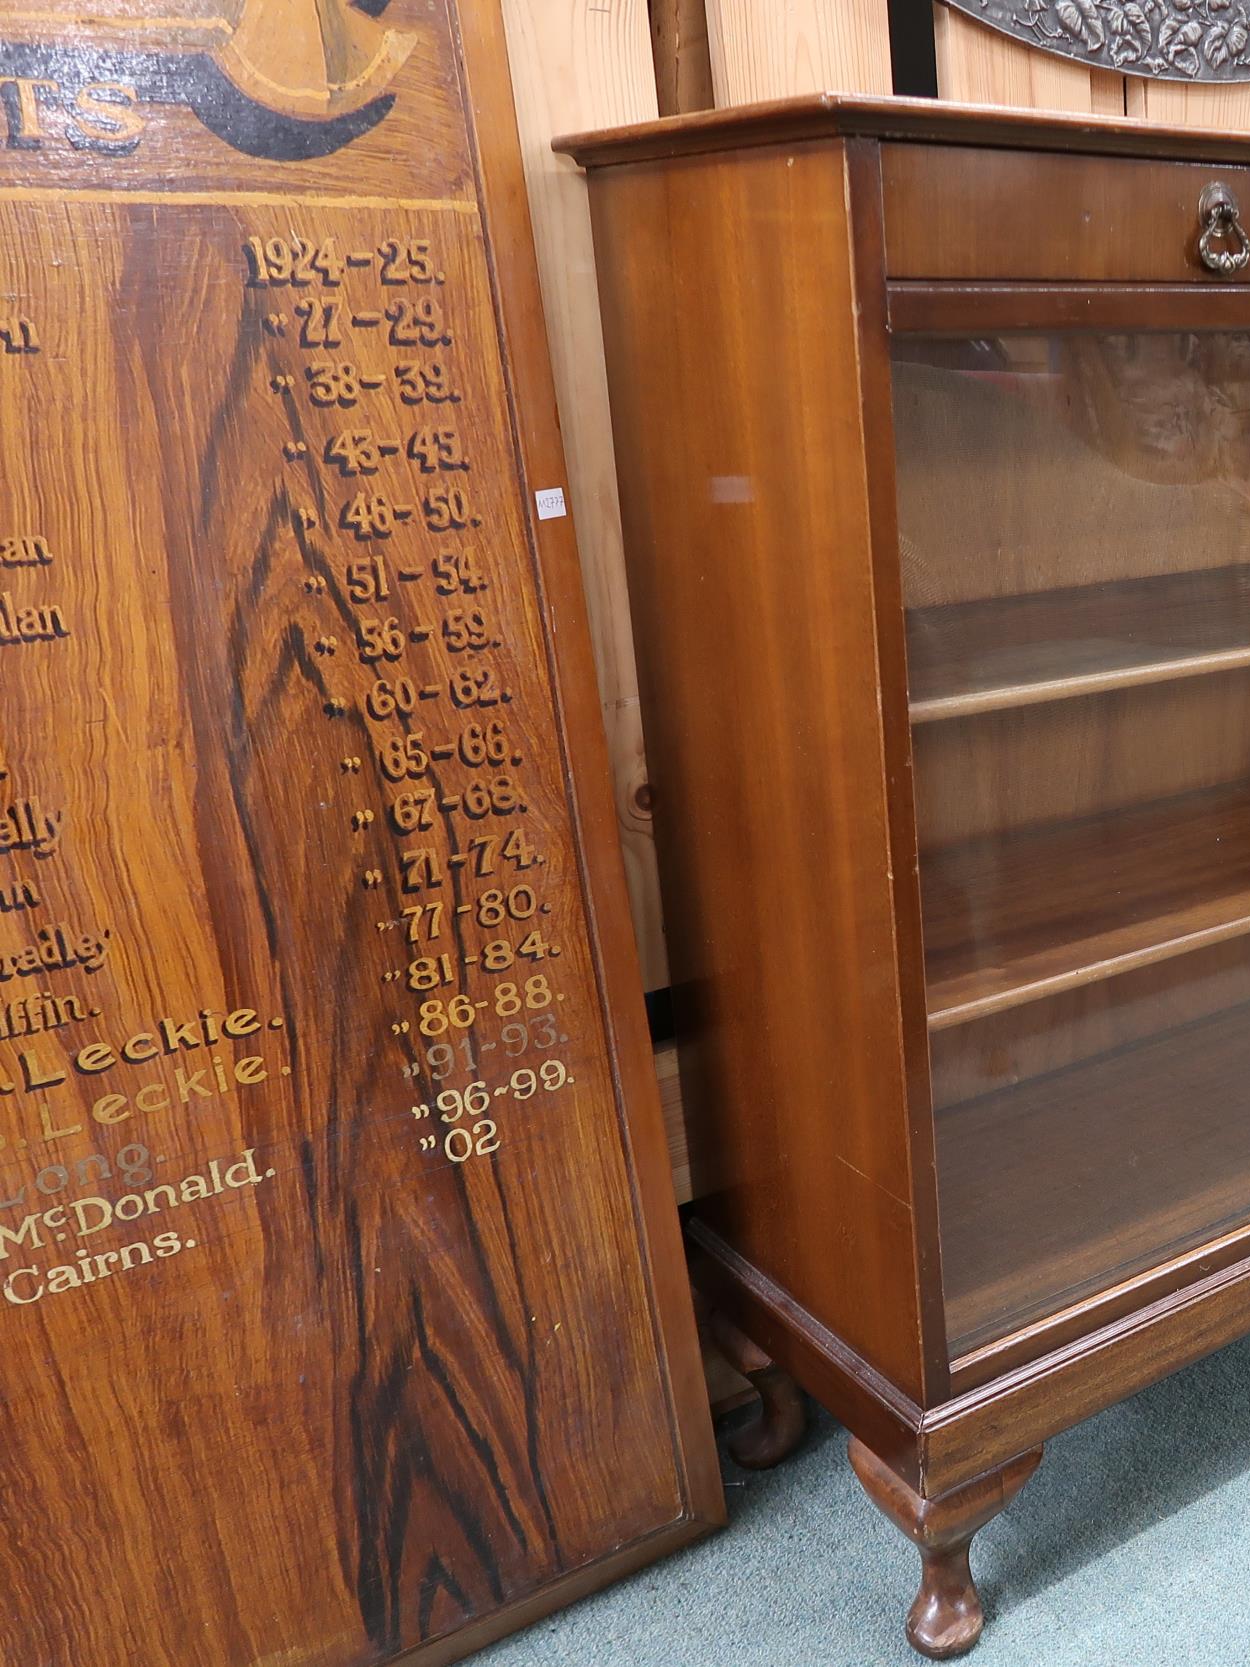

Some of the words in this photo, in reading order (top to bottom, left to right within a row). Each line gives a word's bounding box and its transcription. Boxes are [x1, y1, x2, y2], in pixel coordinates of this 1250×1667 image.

[19, 1008, 284, 1093] Leckie.
[38, 1055, 291, 1142] Leckie.
[3, 1231, 196, 1304] Cairns.
